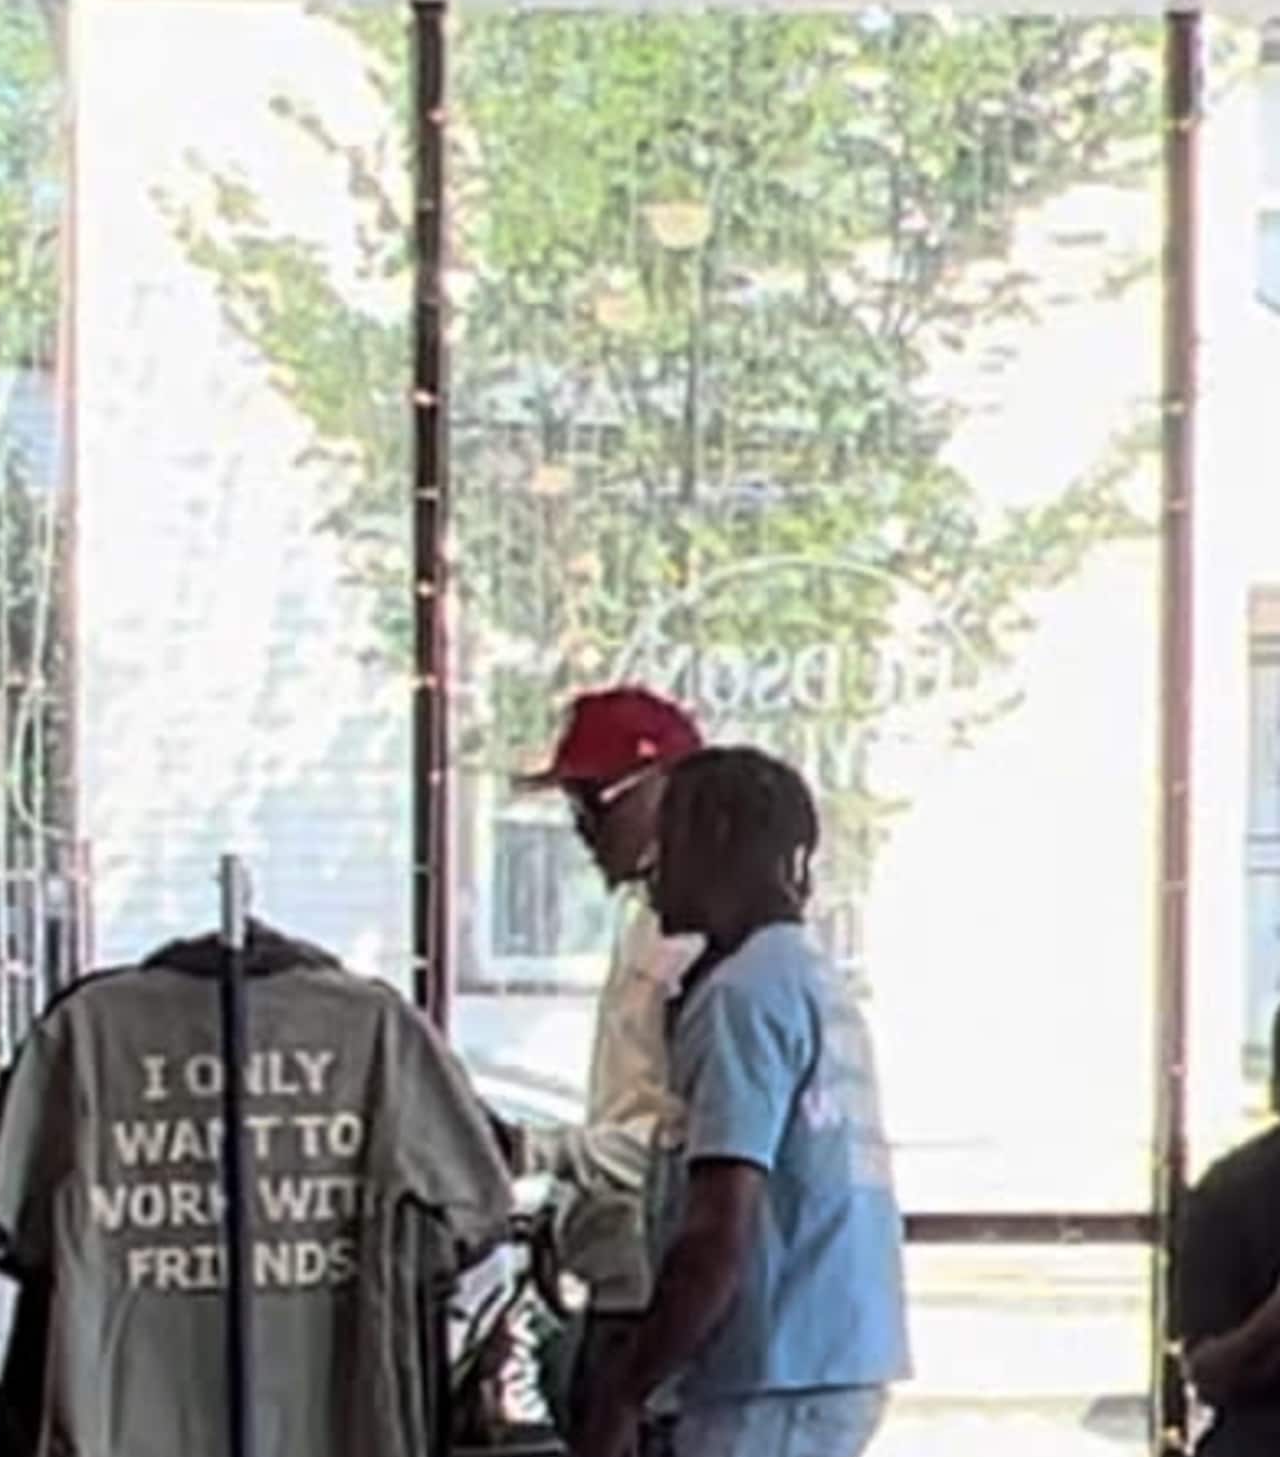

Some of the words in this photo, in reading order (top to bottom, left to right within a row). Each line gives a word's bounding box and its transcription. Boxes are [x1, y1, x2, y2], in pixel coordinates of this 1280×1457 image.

[140, 1054, 169, 1101] I
[293, 1111, 363, 1157] TO
[126, 1241, 354, 1290] FRINDS
